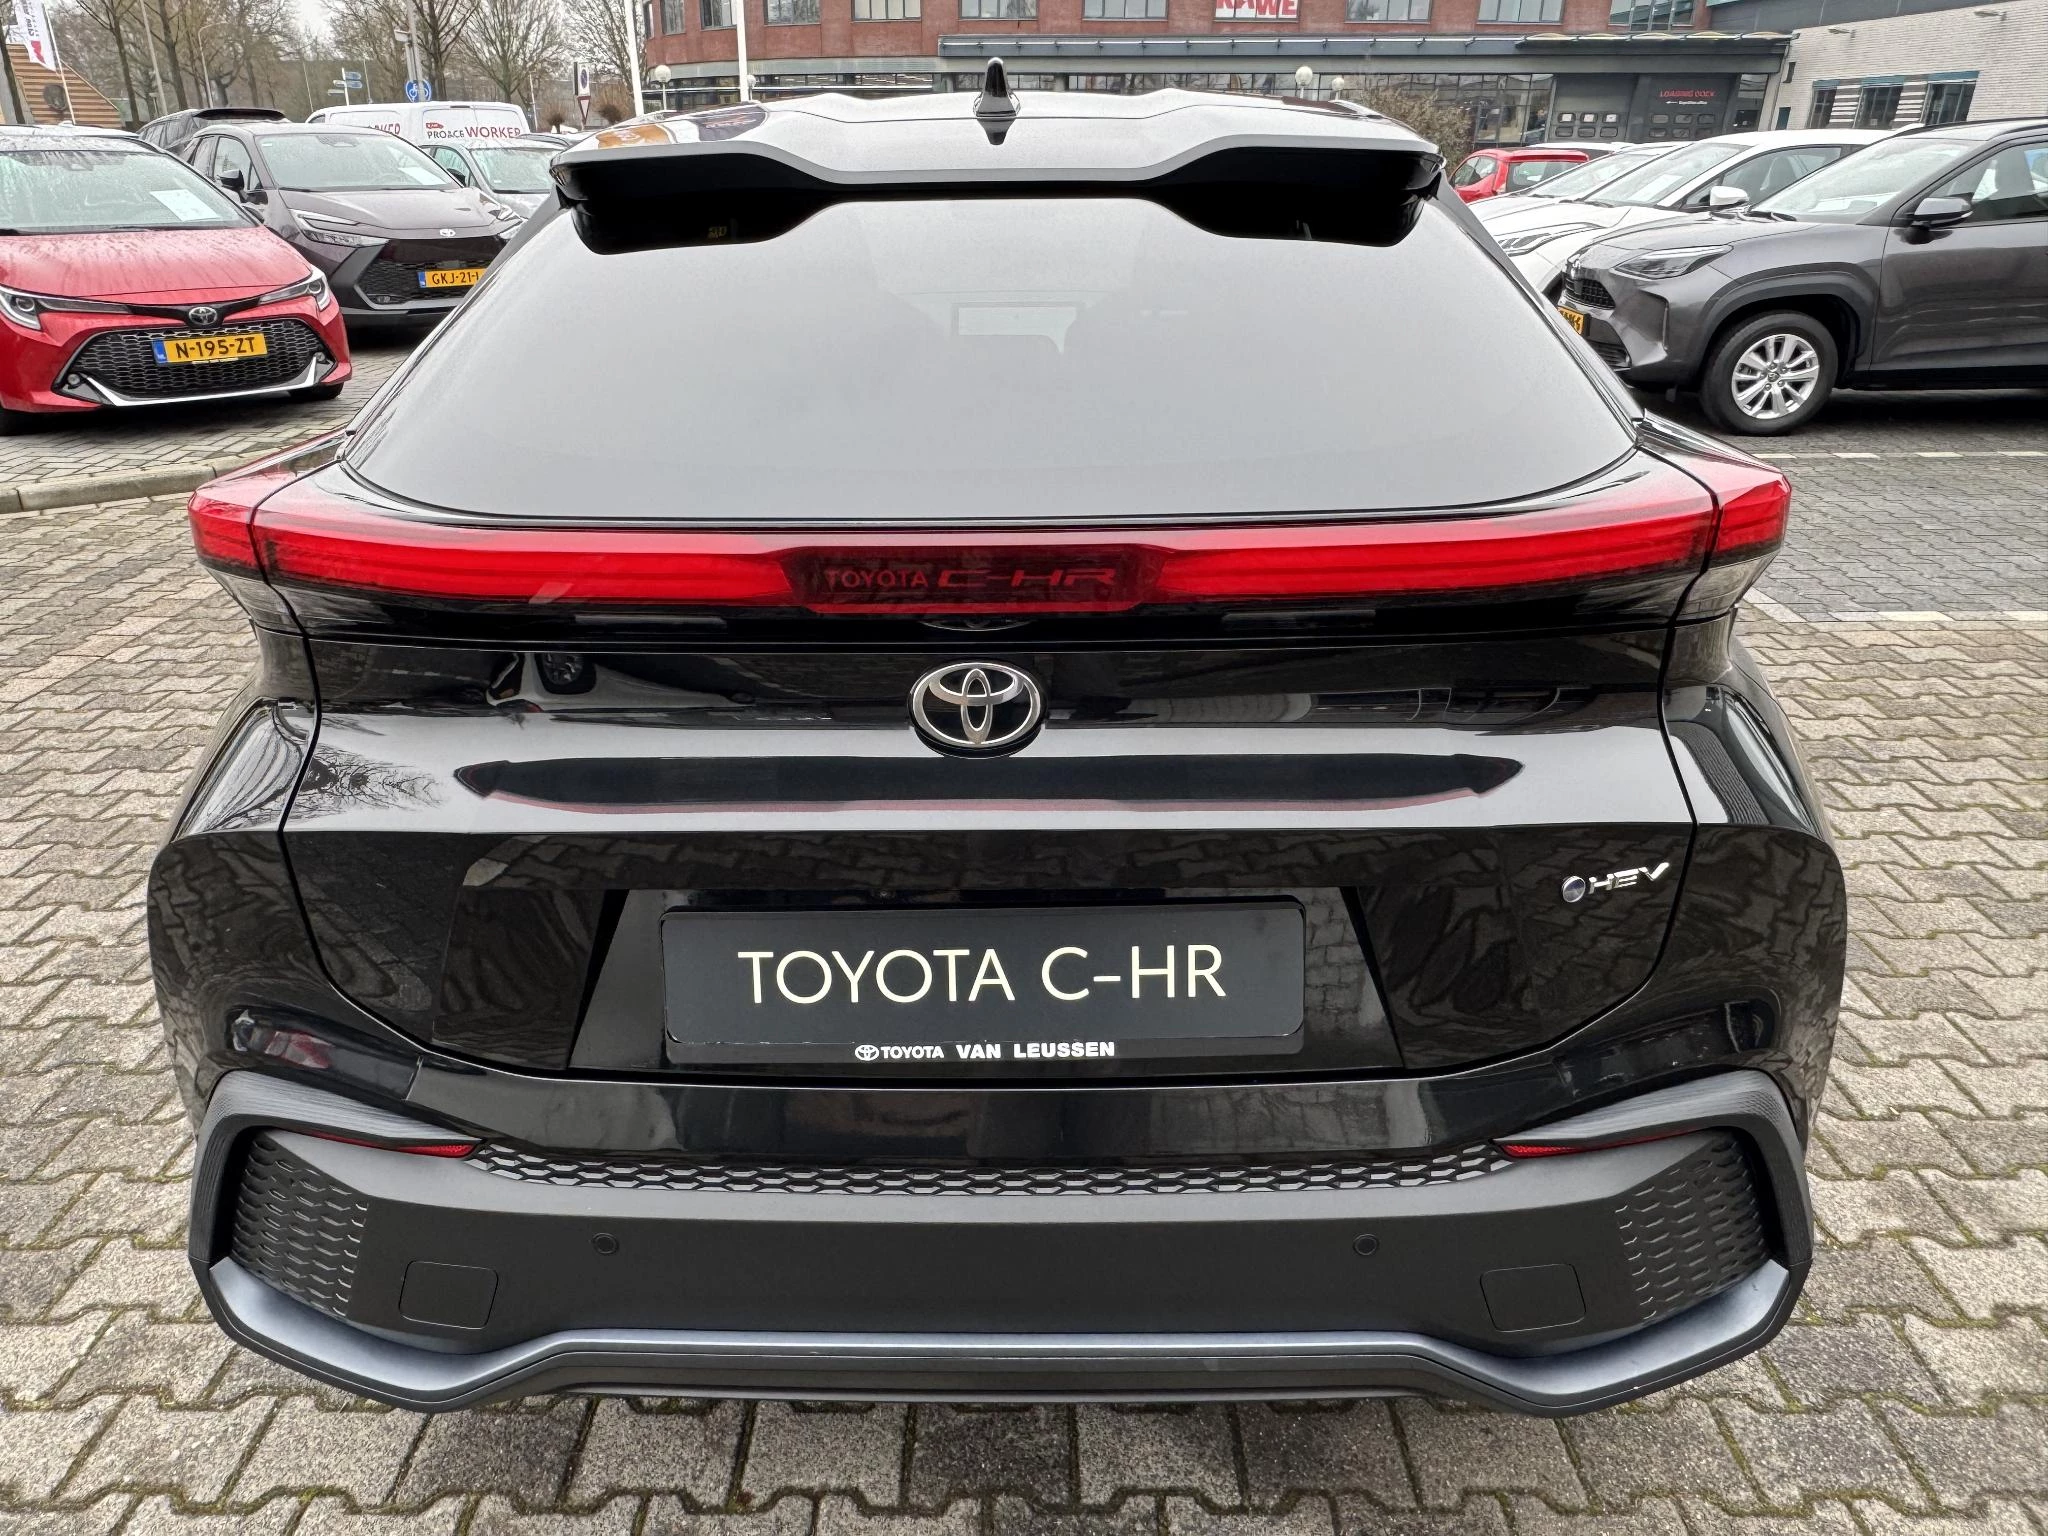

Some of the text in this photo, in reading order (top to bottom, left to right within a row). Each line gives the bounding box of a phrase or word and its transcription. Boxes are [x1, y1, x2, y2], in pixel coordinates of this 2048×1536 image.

[427, 126, 521, 139] PROACE WORKER
[175, 336, 255, 359] N-195-ZT
[824, 568, 1116, 590] TOYOTA C-HR
[1588, 862, 1670, 895] HEV
[737, 943, 1228, 1004] TOYOTA C-HR
[881, 1041, 1115, 1059] TOYOTA VAN LEUSSEN
